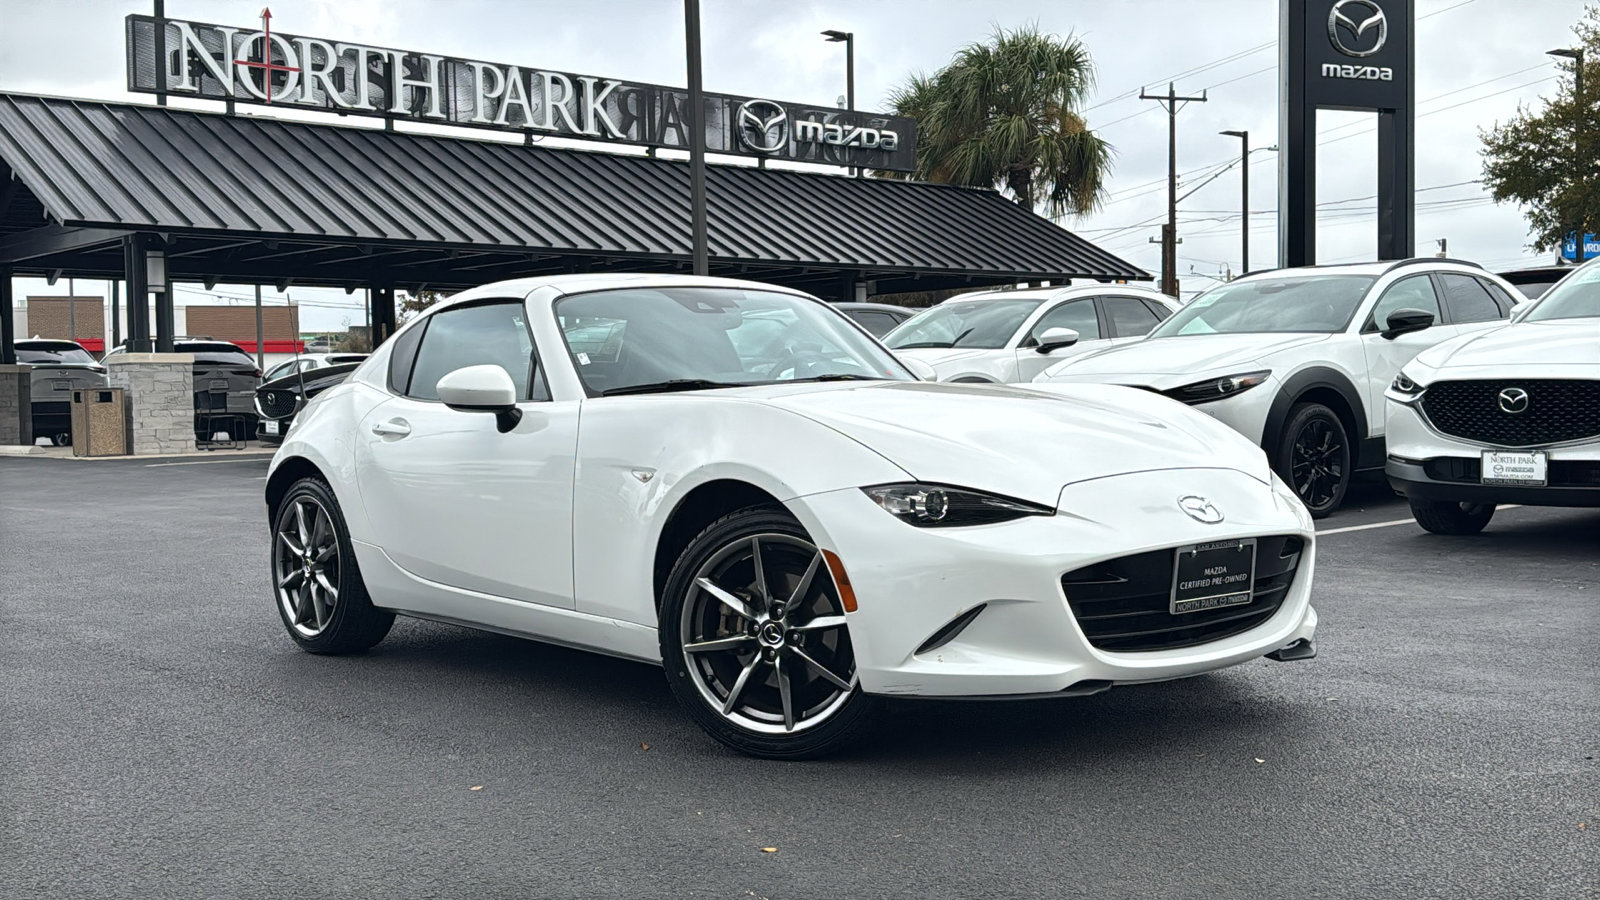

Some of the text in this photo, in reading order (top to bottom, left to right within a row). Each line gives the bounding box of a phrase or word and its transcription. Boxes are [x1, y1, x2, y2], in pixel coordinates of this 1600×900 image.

[1321, 63, 1393, 81] mazda
[168, 20, 899, 151] NORTH PARK mazda
[1204, 566, 1227, 575] MAZDA
[1180, 574, 1247, 590] CERTIFIED PRE-OWNED
[1176, 601, 1200, 612] NORTH
[1201, 598, 1219, 608] PARK
